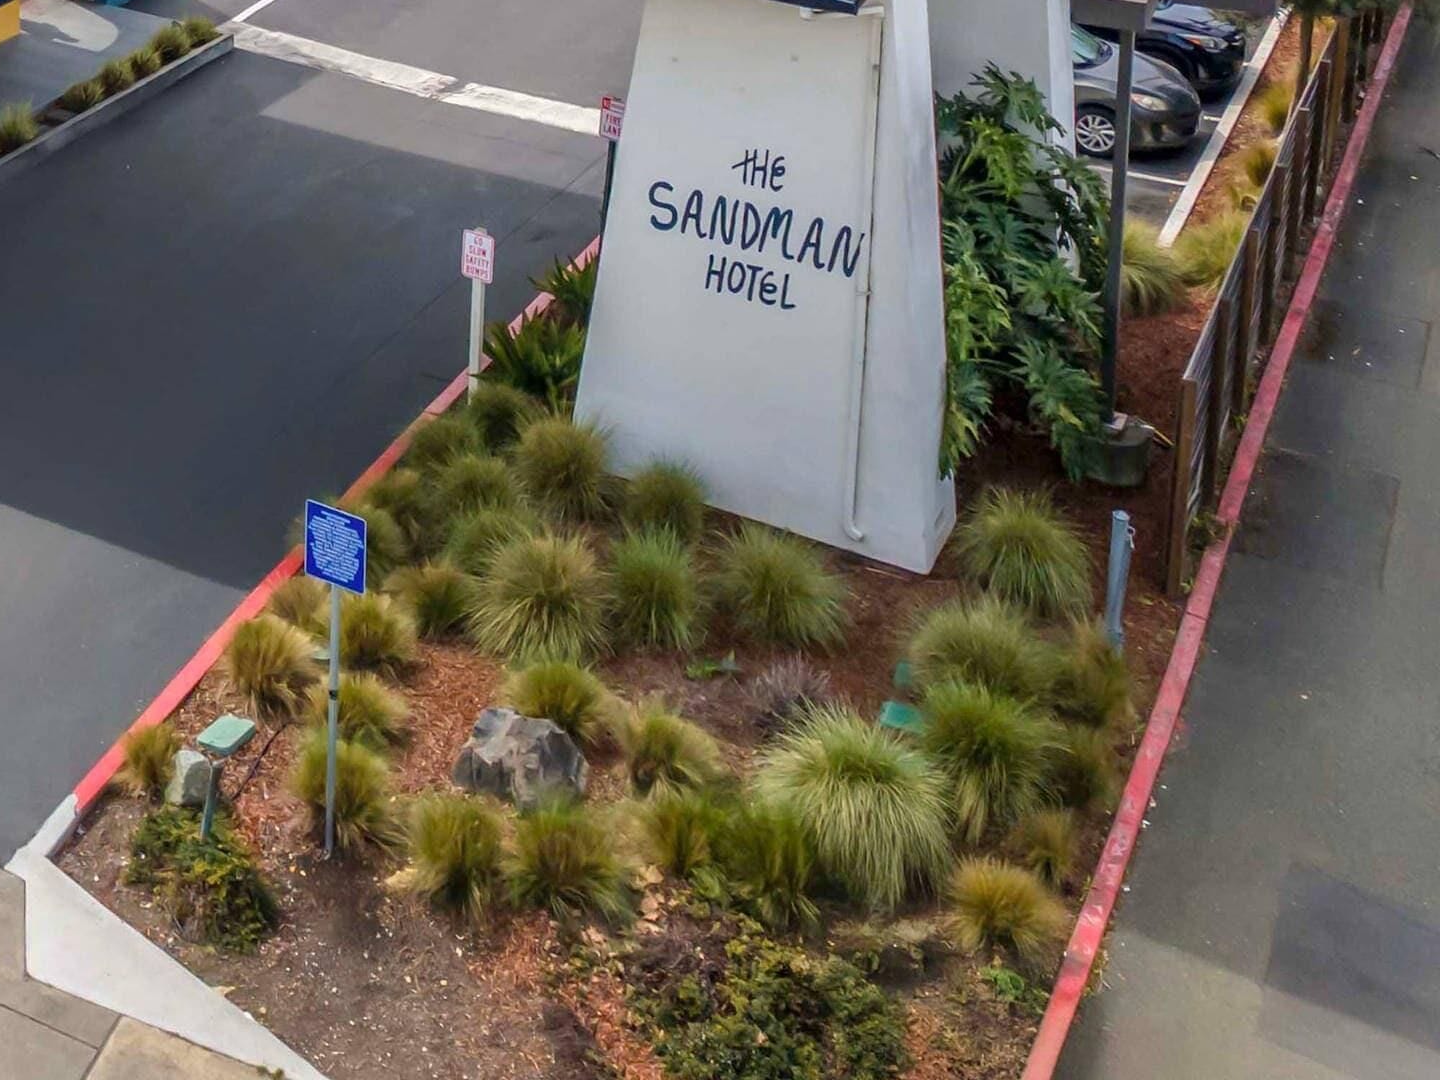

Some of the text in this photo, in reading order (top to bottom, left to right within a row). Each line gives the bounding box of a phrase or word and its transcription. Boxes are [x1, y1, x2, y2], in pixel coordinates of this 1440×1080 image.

[731, 148, 786, 192] THE
[648, 181, 866, 278] SANDMAN
[704, 254, 797, 310] HOTEL
